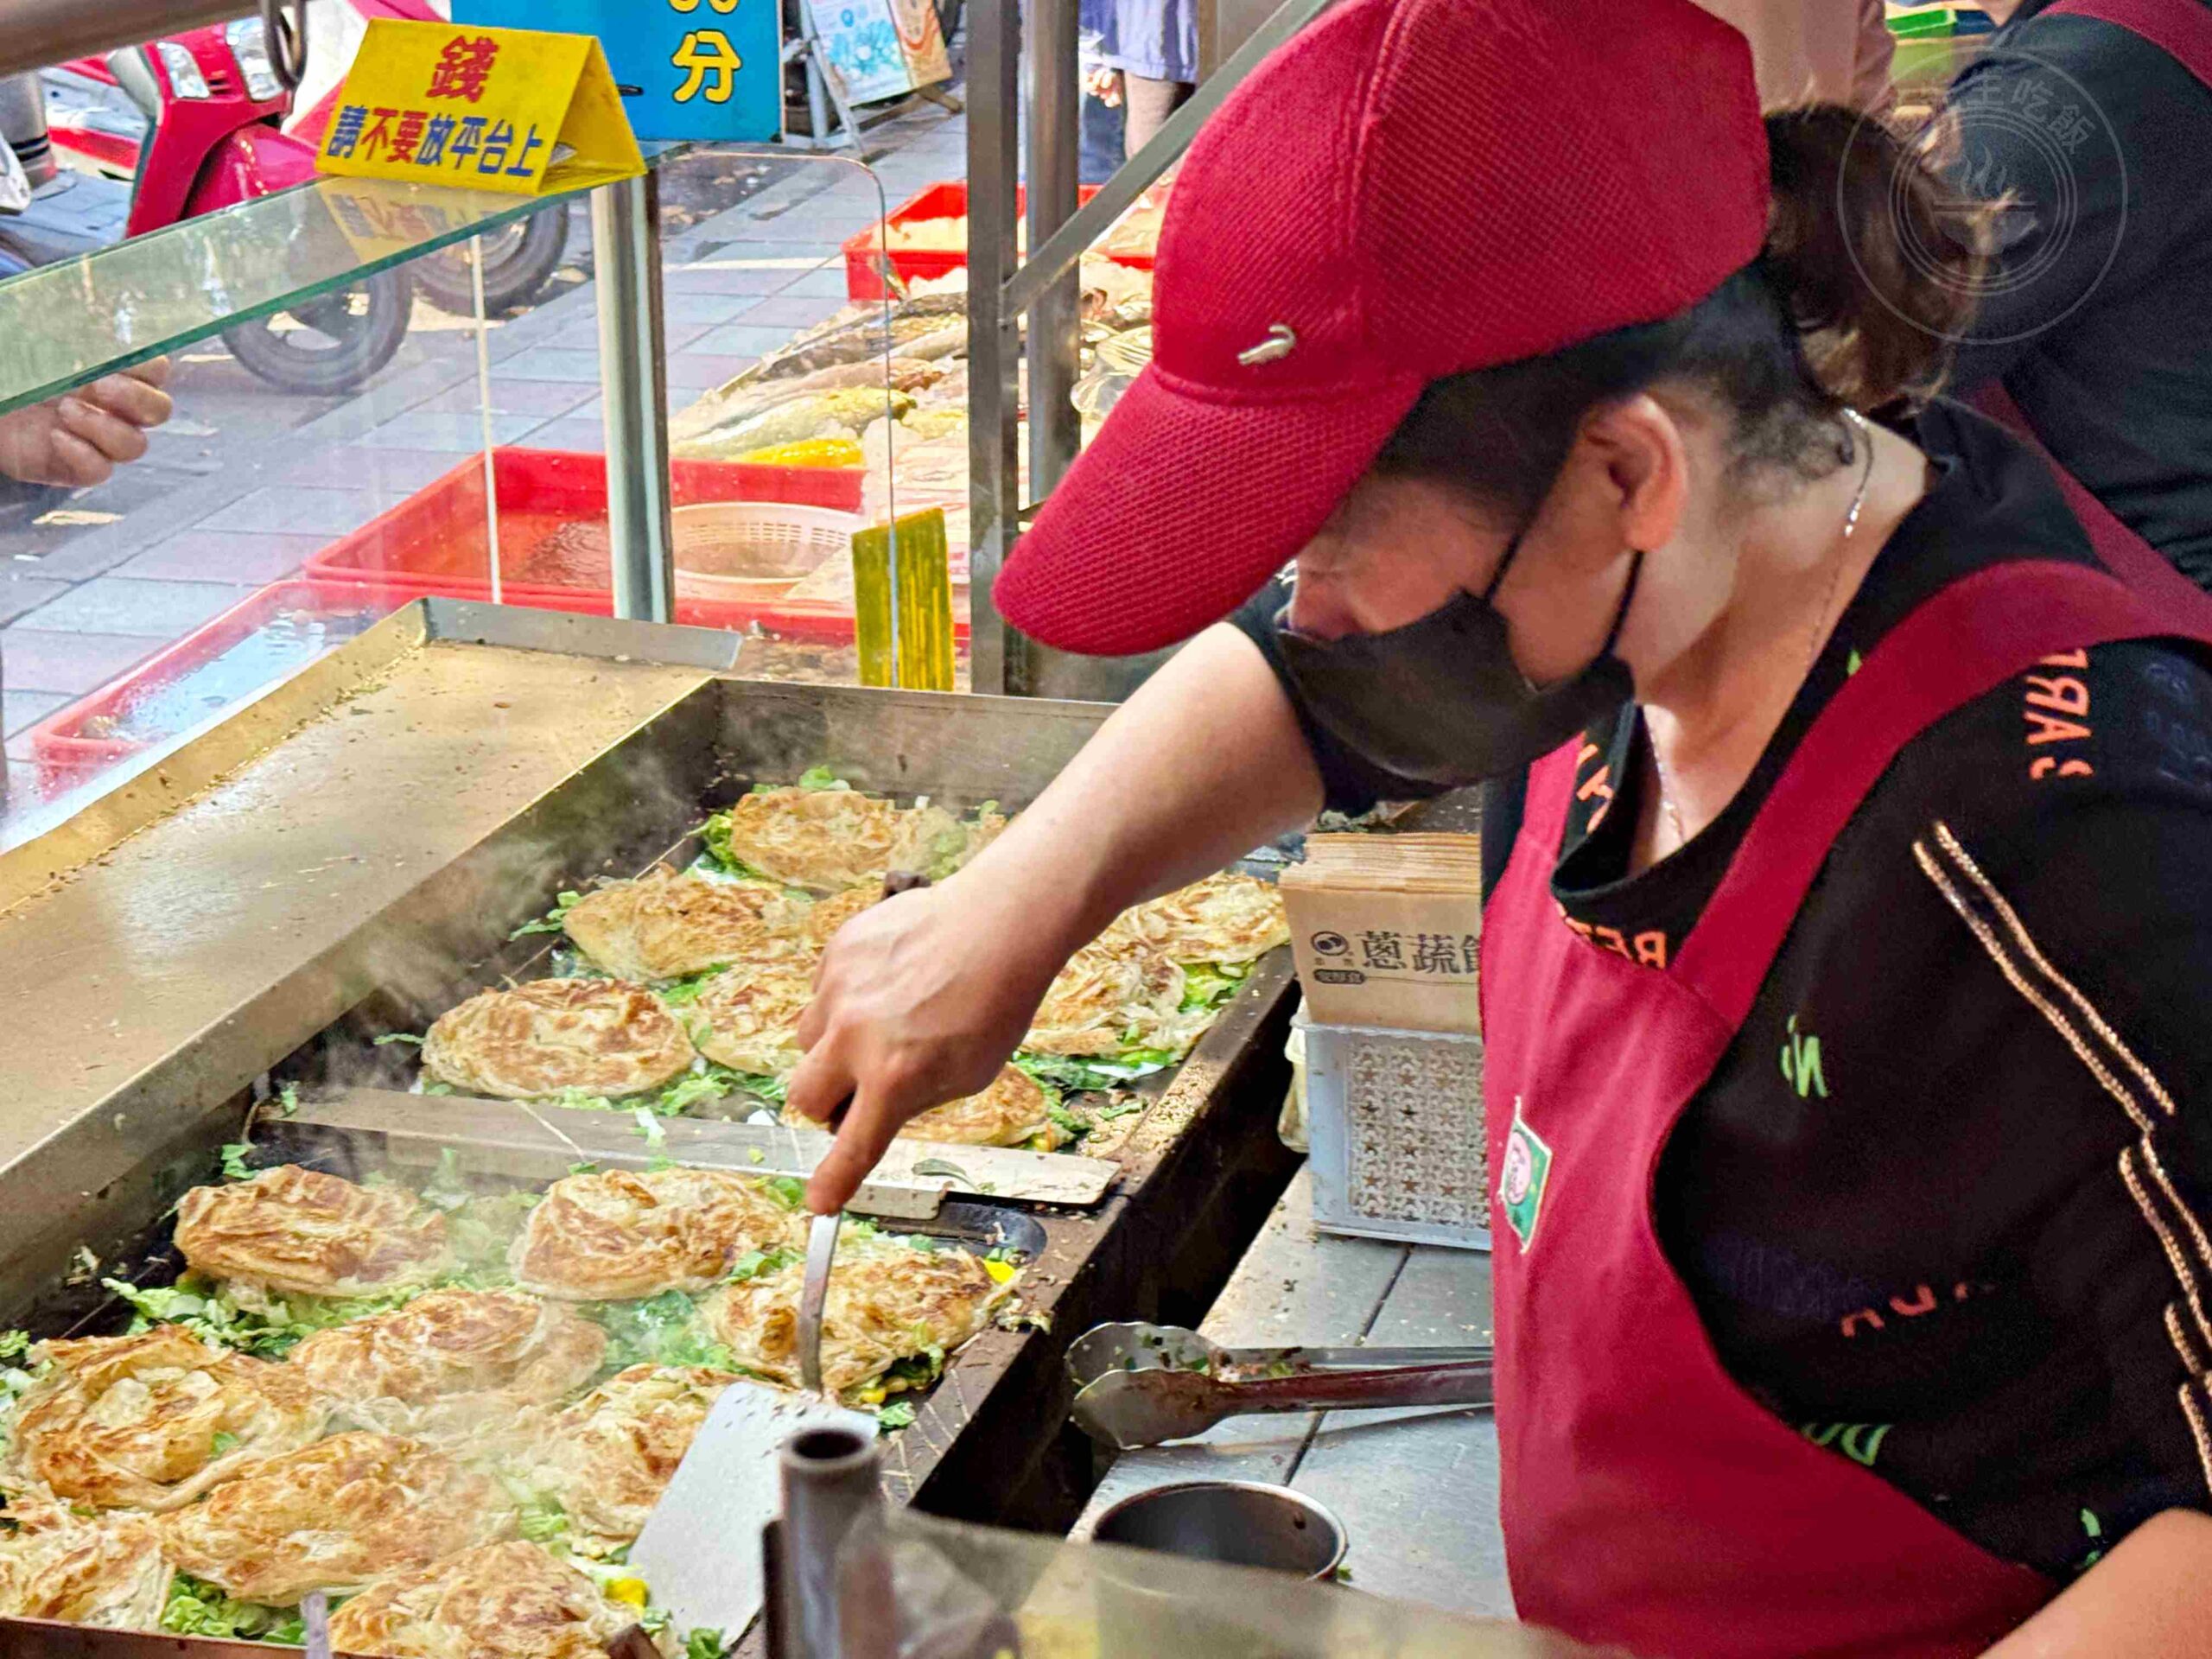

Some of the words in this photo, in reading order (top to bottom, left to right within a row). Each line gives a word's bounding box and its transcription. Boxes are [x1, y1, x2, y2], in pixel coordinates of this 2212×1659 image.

[426, 35, 500, 104] 錢
[671, 29, 743, 105] 分
[327, 105, 543, 177] 請不要放平台上
